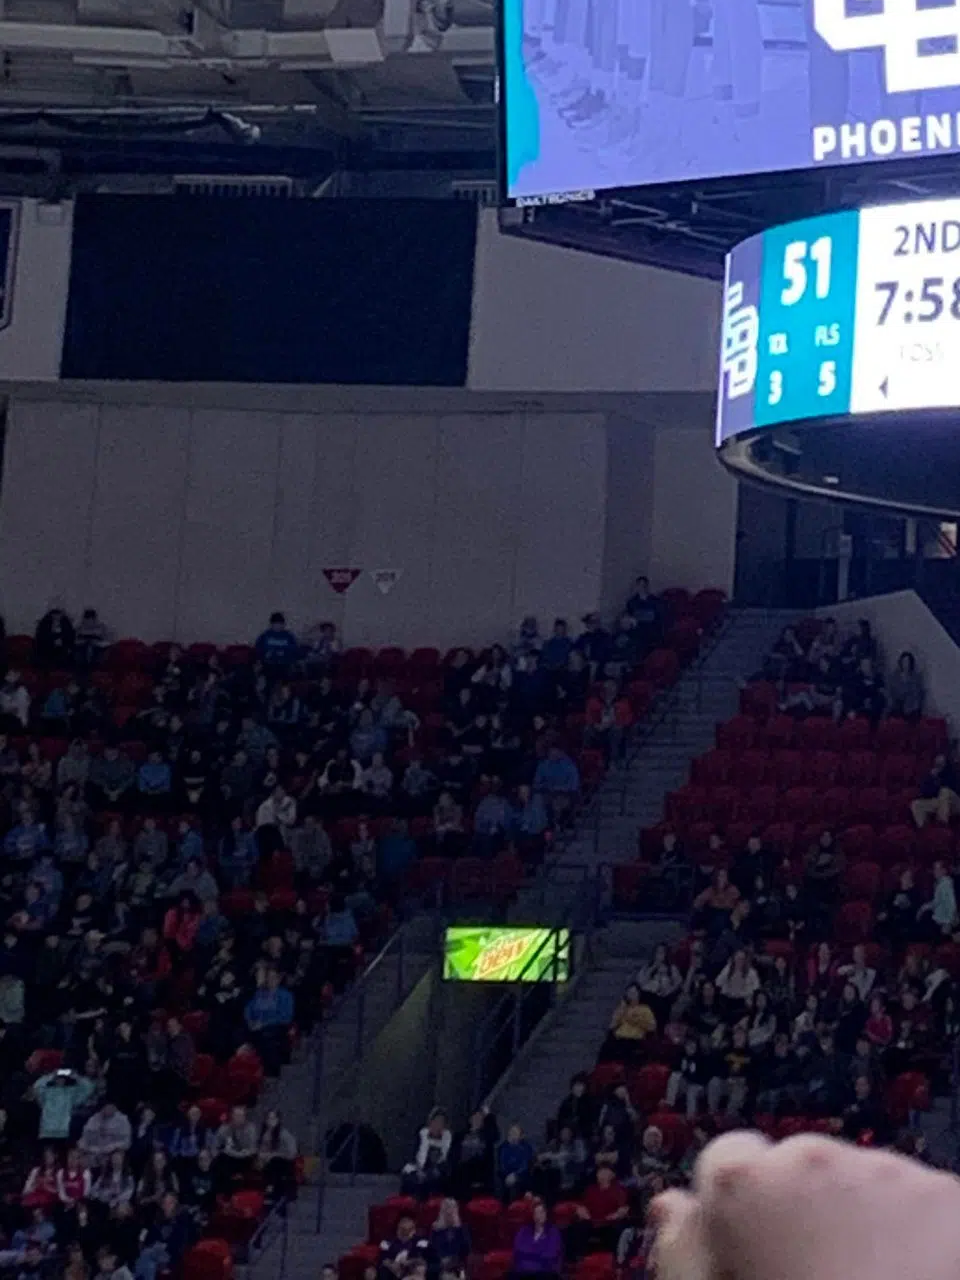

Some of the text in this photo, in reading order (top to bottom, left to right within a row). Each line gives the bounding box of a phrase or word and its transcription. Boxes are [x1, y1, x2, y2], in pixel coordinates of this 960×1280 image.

[780, 236, 832, 306] 51
[767, 370, 782, 405] 3
[817, 360, 836, 396] 5
